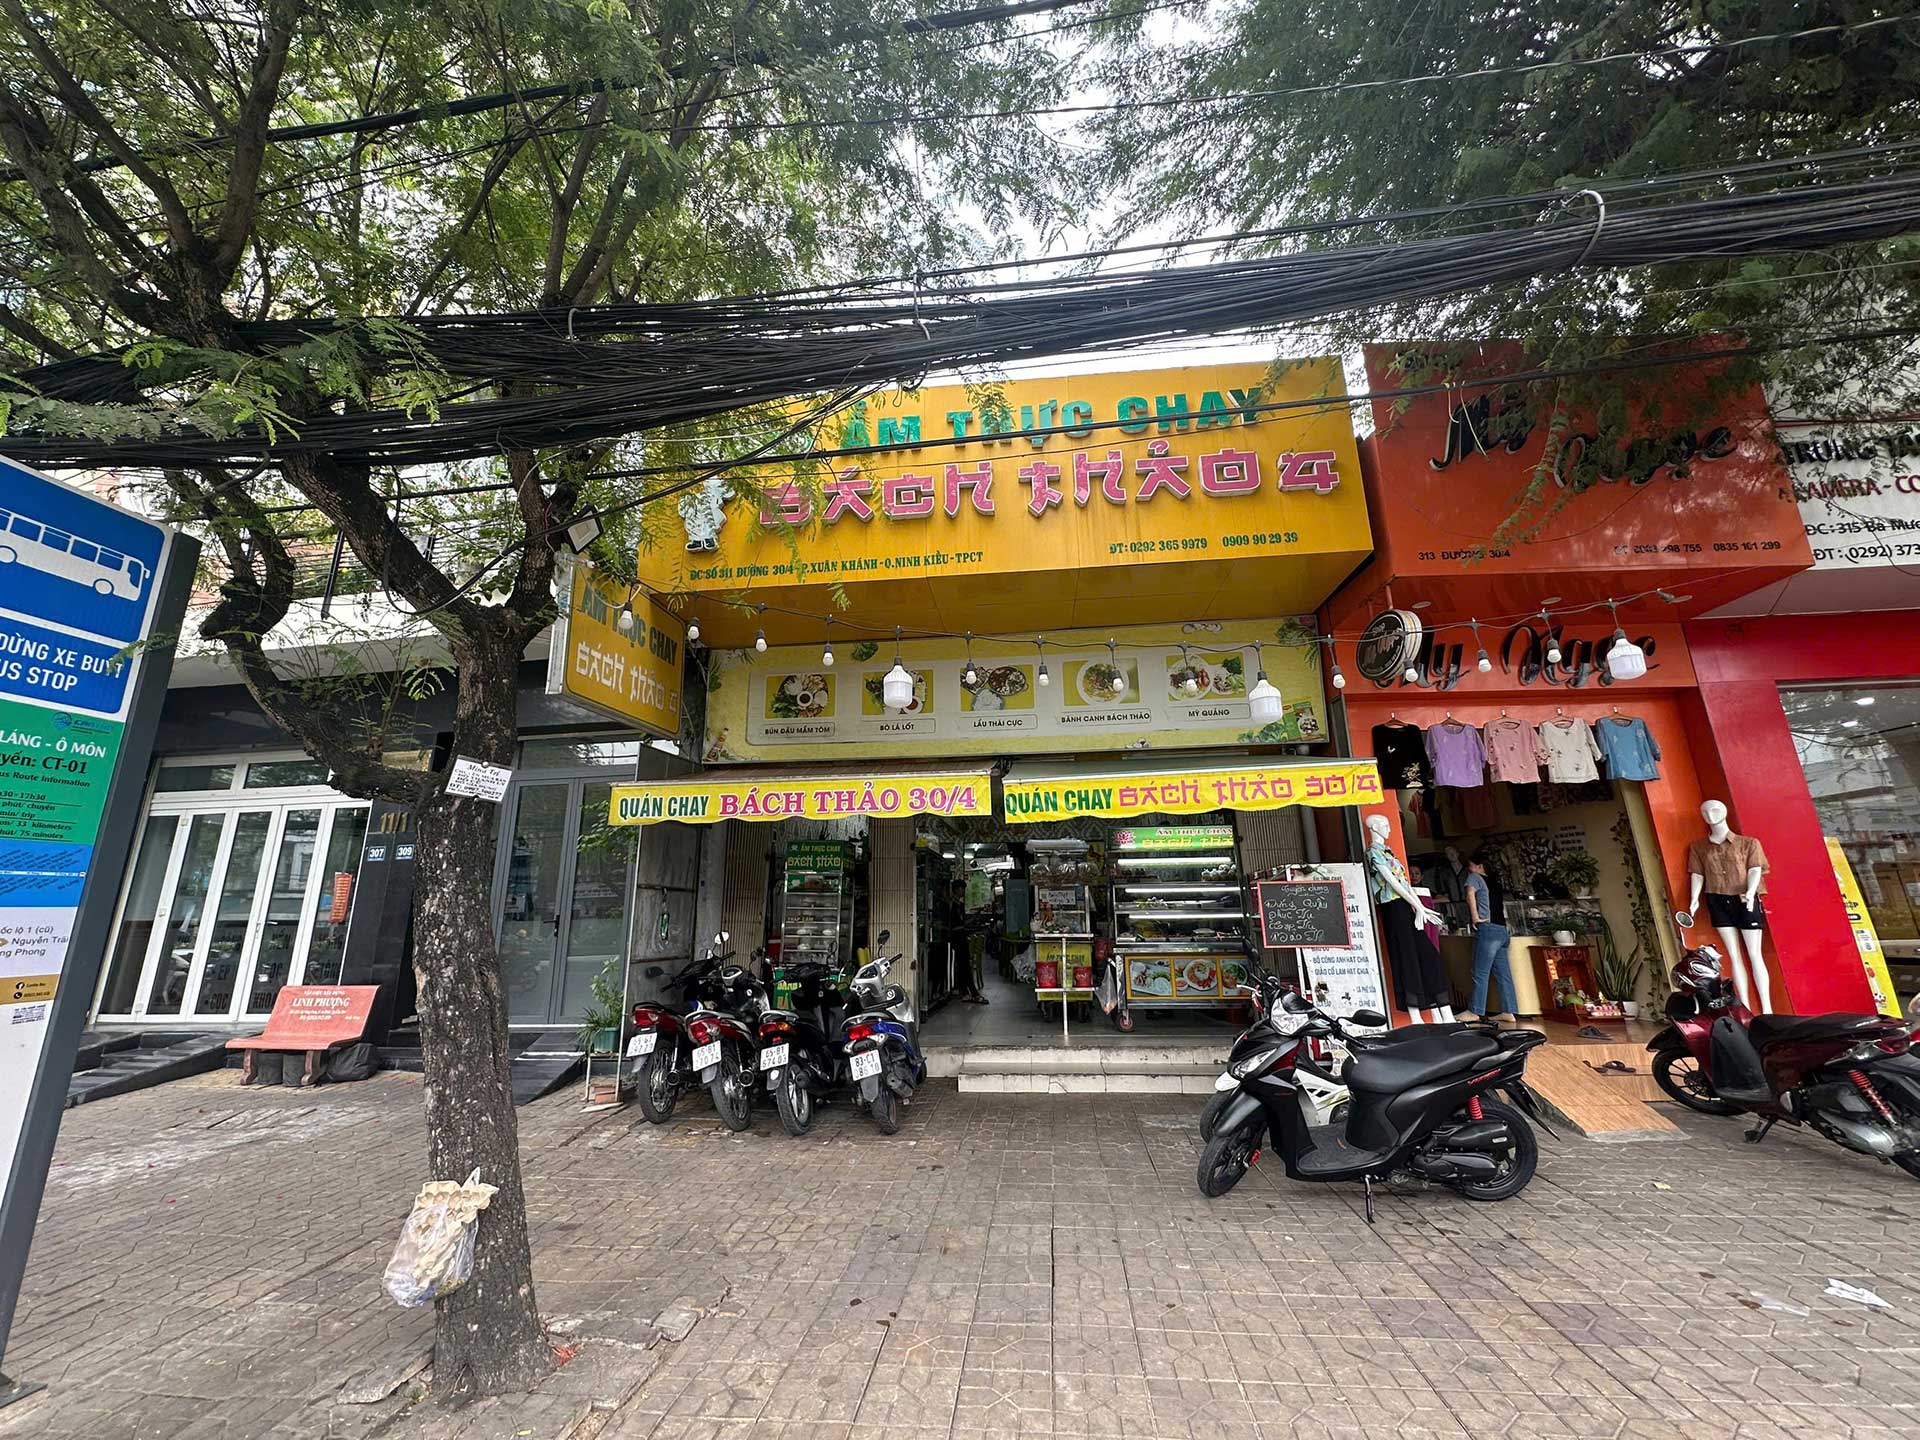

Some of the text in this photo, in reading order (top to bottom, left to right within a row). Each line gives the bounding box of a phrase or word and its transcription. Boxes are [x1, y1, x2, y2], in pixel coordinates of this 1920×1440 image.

[947, 398, 1093, 449] THỰC
[1117, 387, 1262, 434] CHAY
[759, 439, 1340, 527] BÁCH THẢO 4
[1838, 522, 1861, 533] 315
[1159, 539, 1179, 551] 365
[1182, 537, 1208, 550] 9979
[1222, 534, 1250, 547] 0909
[1252, 534, 1267, 545] 90
[1268, 533, 1282, 544] 29
[1683, 543, 1702, 553] 755
[1713, 542, 1739, 551] 0835
[1741, 542, 1758, 550] 101
[1760, 541, 1781, 550] 299
[736, 563, 769, 578] ĐƯỜNG
[924, 550, 949, 566] KIỀU
[955, 551, 983, 563] TPCT
[1418, 551, 1436, 561] 313
[52, 647, 78, 668] XE
[0, 659, 78, 691] US STOP
[1083, 714, 1104, 722] CANH
[55, 736, 68, 752] Ô
[70, 741, 106, 758] MÔN
[42, 755, 87, 774] CT-01
[619, 781, 977, 819] QUÁN CHAY BÁCH THẢO 30/4
[1005, 773, 1379, 815] QUÁN CHAY BÁCH THẢO 30/4
[369, 848, 385, 858] 307
[397, 846, 412, 856] 309
[15, 948, 46, 957] Phong
[292, 996, 351, 1009] LINH PHƯỢNG
